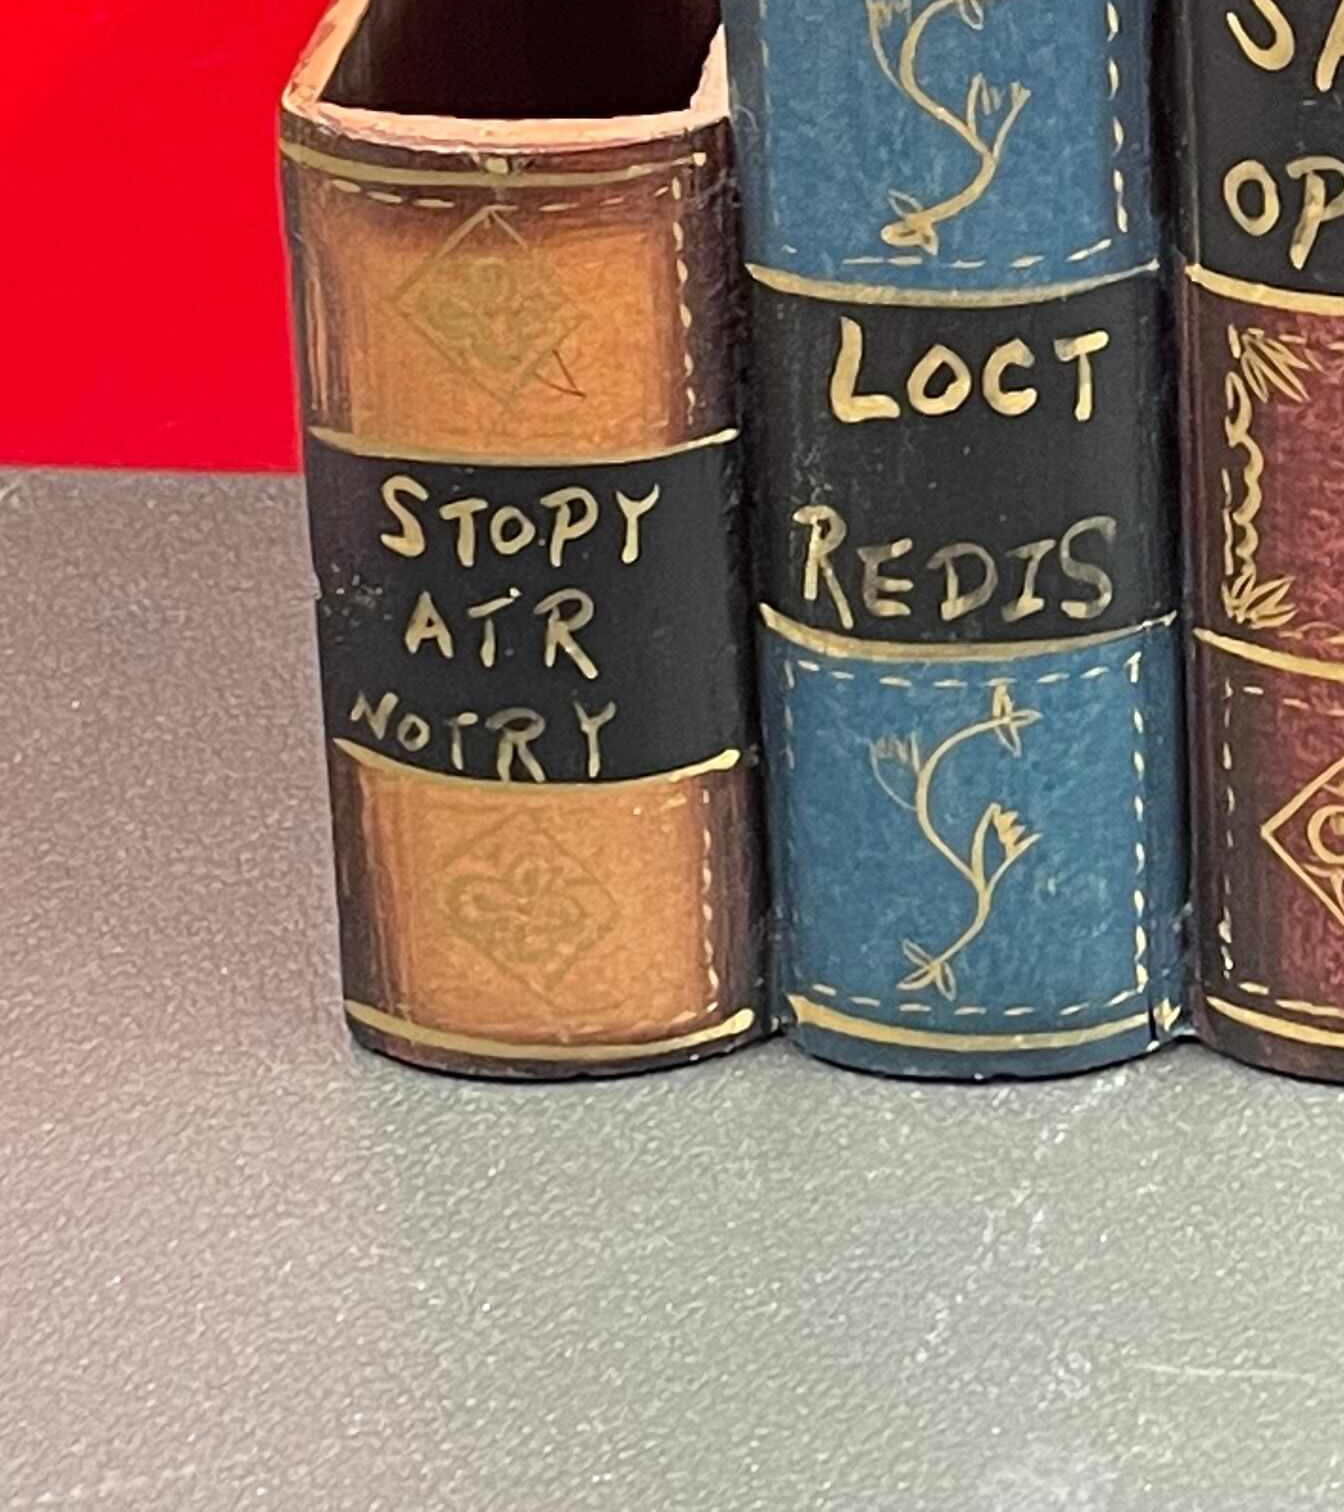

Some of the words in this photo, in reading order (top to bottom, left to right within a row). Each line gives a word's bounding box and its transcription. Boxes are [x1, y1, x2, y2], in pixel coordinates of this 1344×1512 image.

[830, 316, 1110, 424] LOCT
[380, 474, 660, 567] STOPY
[792, 504, 1117, 629] REDIS
[404, 588, 599, 679] ATR
[349, 691, 617, 782] NOTRY
